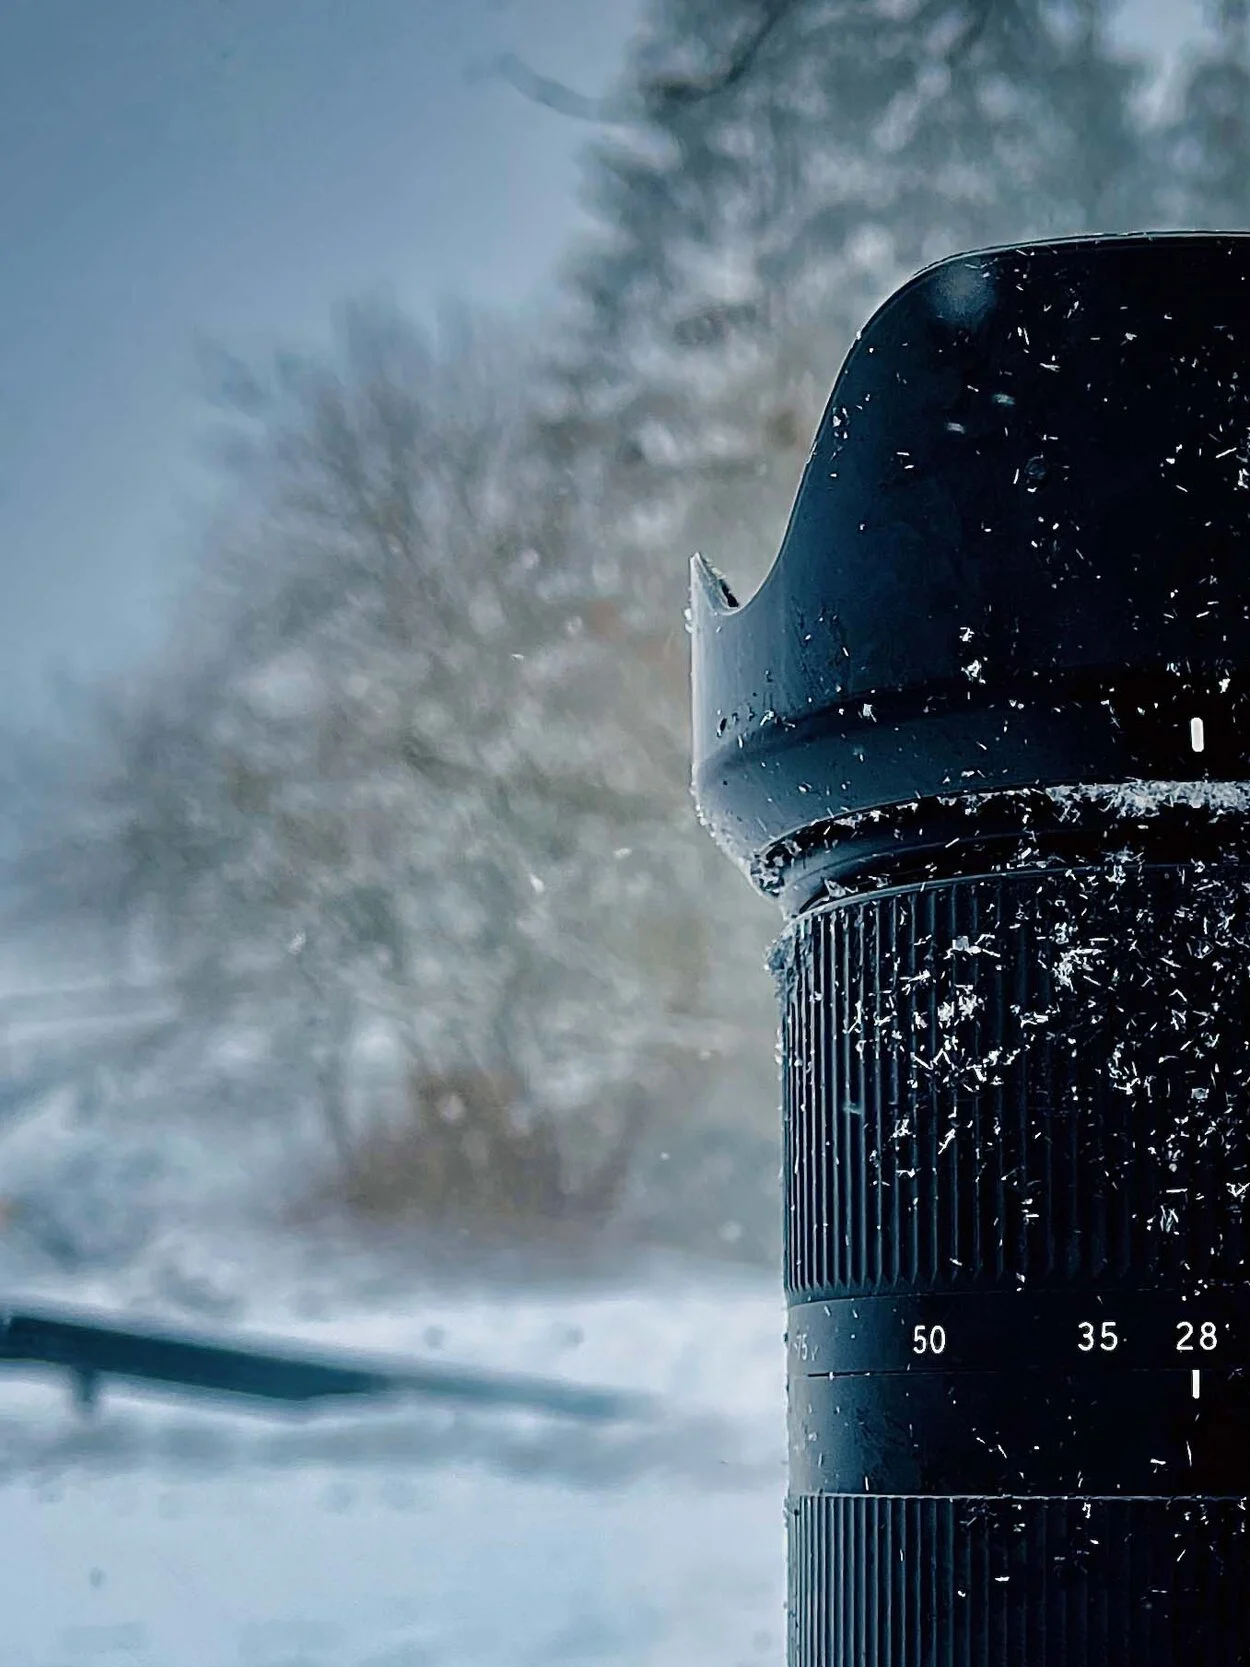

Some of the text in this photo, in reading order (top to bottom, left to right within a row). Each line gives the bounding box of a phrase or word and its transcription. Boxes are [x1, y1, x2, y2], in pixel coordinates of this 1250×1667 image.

[912, 1325, 946, 1354] 50
[1077, 1321, 1118, 1351] 35
[1175, 1321, 1217, 1351] 28
